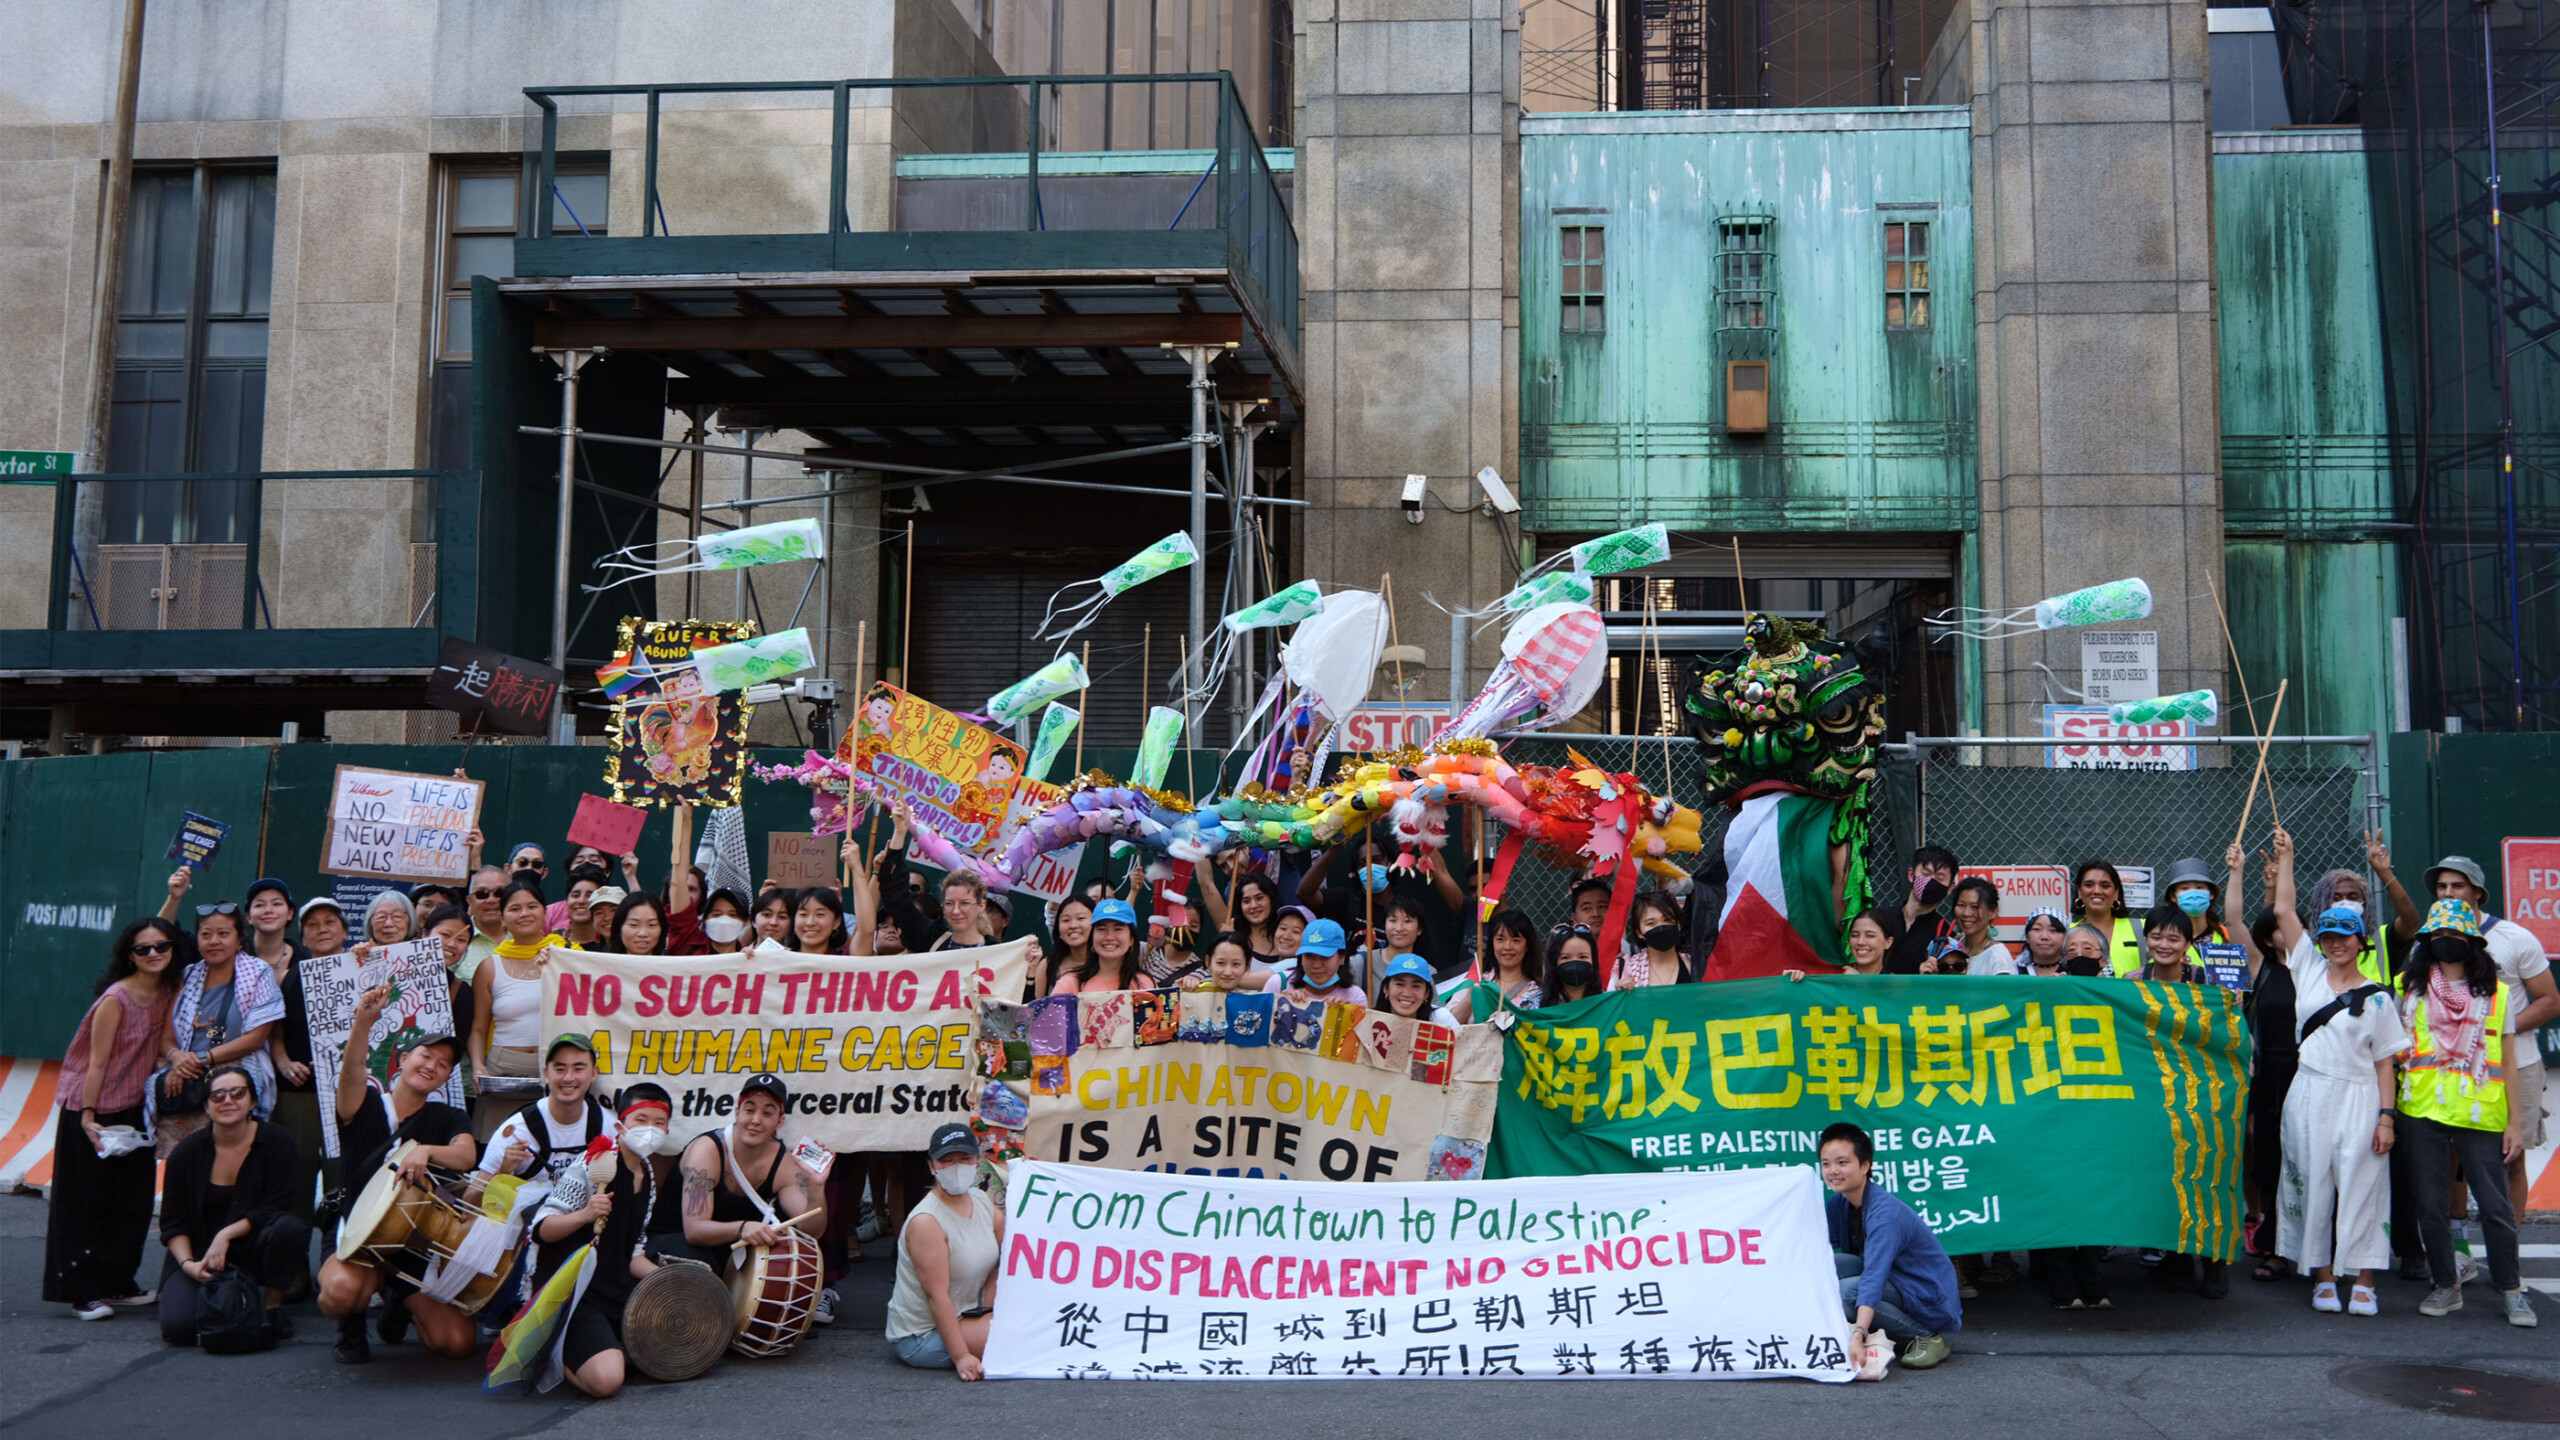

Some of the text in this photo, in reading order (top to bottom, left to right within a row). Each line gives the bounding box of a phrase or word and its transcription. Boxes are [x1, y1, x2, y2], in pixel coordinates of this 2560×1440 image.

[44, 454, 57, 469] St
[2083, 633, 2155, 645] PLEASE RESPECT OUR
[643, 645, 688, 659] ABUND
[2112, 669, 2126, 680] AND
[440, 660, 555, 721] 一起勝利
[2088, 686, 2101, 698] USE
[2062, 718, 2181, 757] STOP
[876, 753, 940, 797] TRANS
[411, 781, 471, 810] LIFE IS
[350, 801, 385, 822] NO
[410, 805, 469, 831] PRECIOUS
[344, 825, 395, 847] NEW
[404, 828, 458, 852] LIFE IS
[774, 838, 826, 855] NO more
[338, 849, 393, 872] JAILS
[777, 862, 824, 879] JAILS
[1996, 878, 2062, 896] PARKING
[59, 905, 77, 927] NO
[411, 939, 441, 952] THE
[301, 956, 341, 973] WHEN
[406, 953, 443, 967] REAL
[302, 970, 332, 985] THE
[399, 962, 446, 982] DRAGON
[305, 978, 355, 999] PRISON
[413, 975, 447, 991] WILL
[554, 968, 994, 1017] NO SUCH THING AS
[306, 993, 353, 1013] DOORS
[424, 987, 448, 1001] FLY
[308, 1009, 338, 1025] ARE
[424, 1001, 449, 1015] OUT
[625, 1027, 832, 1075] HUMANE
[840, 1023, 970, 1073] CAGE
[1514, 1002, 2135, 1123] 解放巴勒斯坦
[681, 1088, 733, 1117] the
[783, 1085, 884, 1115] rceral
[1077, 1062, 1392, 1136] CHINATOWN
[1058, 1120, 1109, 1162] IS
[1136, 1114, 1163, 1158] A
[1193, 1116, 1302, 1166] SITE
[1318, 1137, 1399, 1182] OF
[1631, 1134, 1692, 1158] FREE
[1701, 1130, 1824, 1154] PALESTIN
[1911, 1124, 1997, 1149] GAZA
[1016, 1174, 1668, 1243] From Chinatown to Palestine:
[1007, 1229, 1766, 1300] NO DISPLACEMENT NO GENOCIDE
